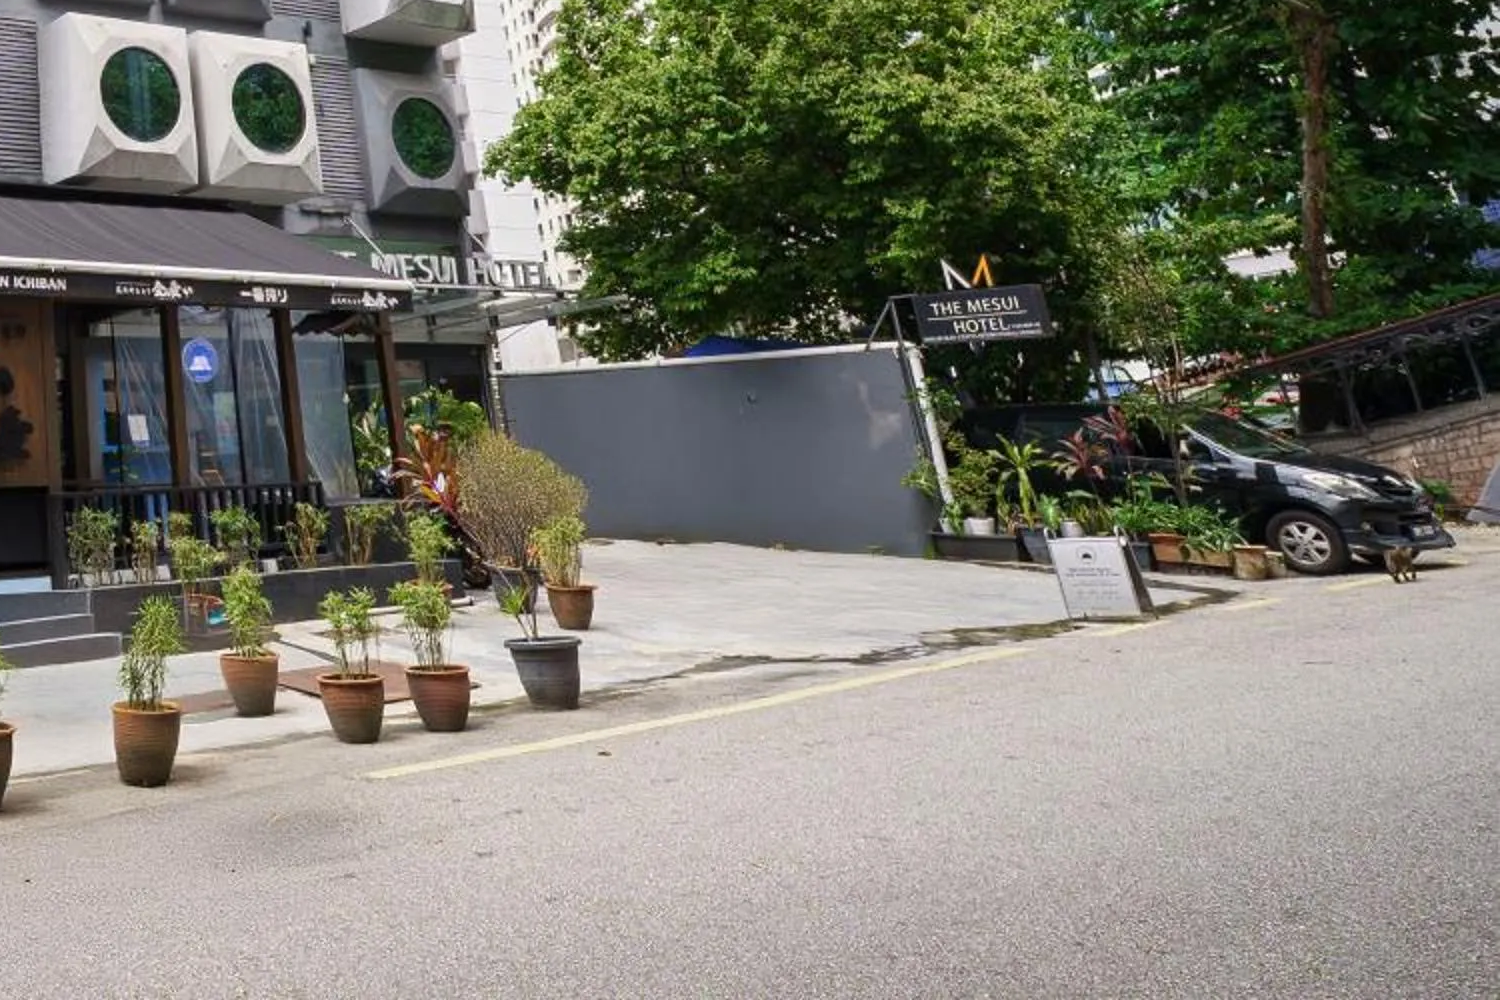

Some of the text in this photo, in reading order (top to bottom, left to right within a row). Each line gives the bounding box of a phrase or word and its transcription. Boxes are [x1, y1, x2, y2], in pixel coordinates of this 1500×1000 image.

[369, 253, 457, 285] MESUI
[13, 275, 67, 291] ICHIBAN
[929, 295, 1020, 317] THE MESUI
[952, 317, 1010, 334] HOTEL
